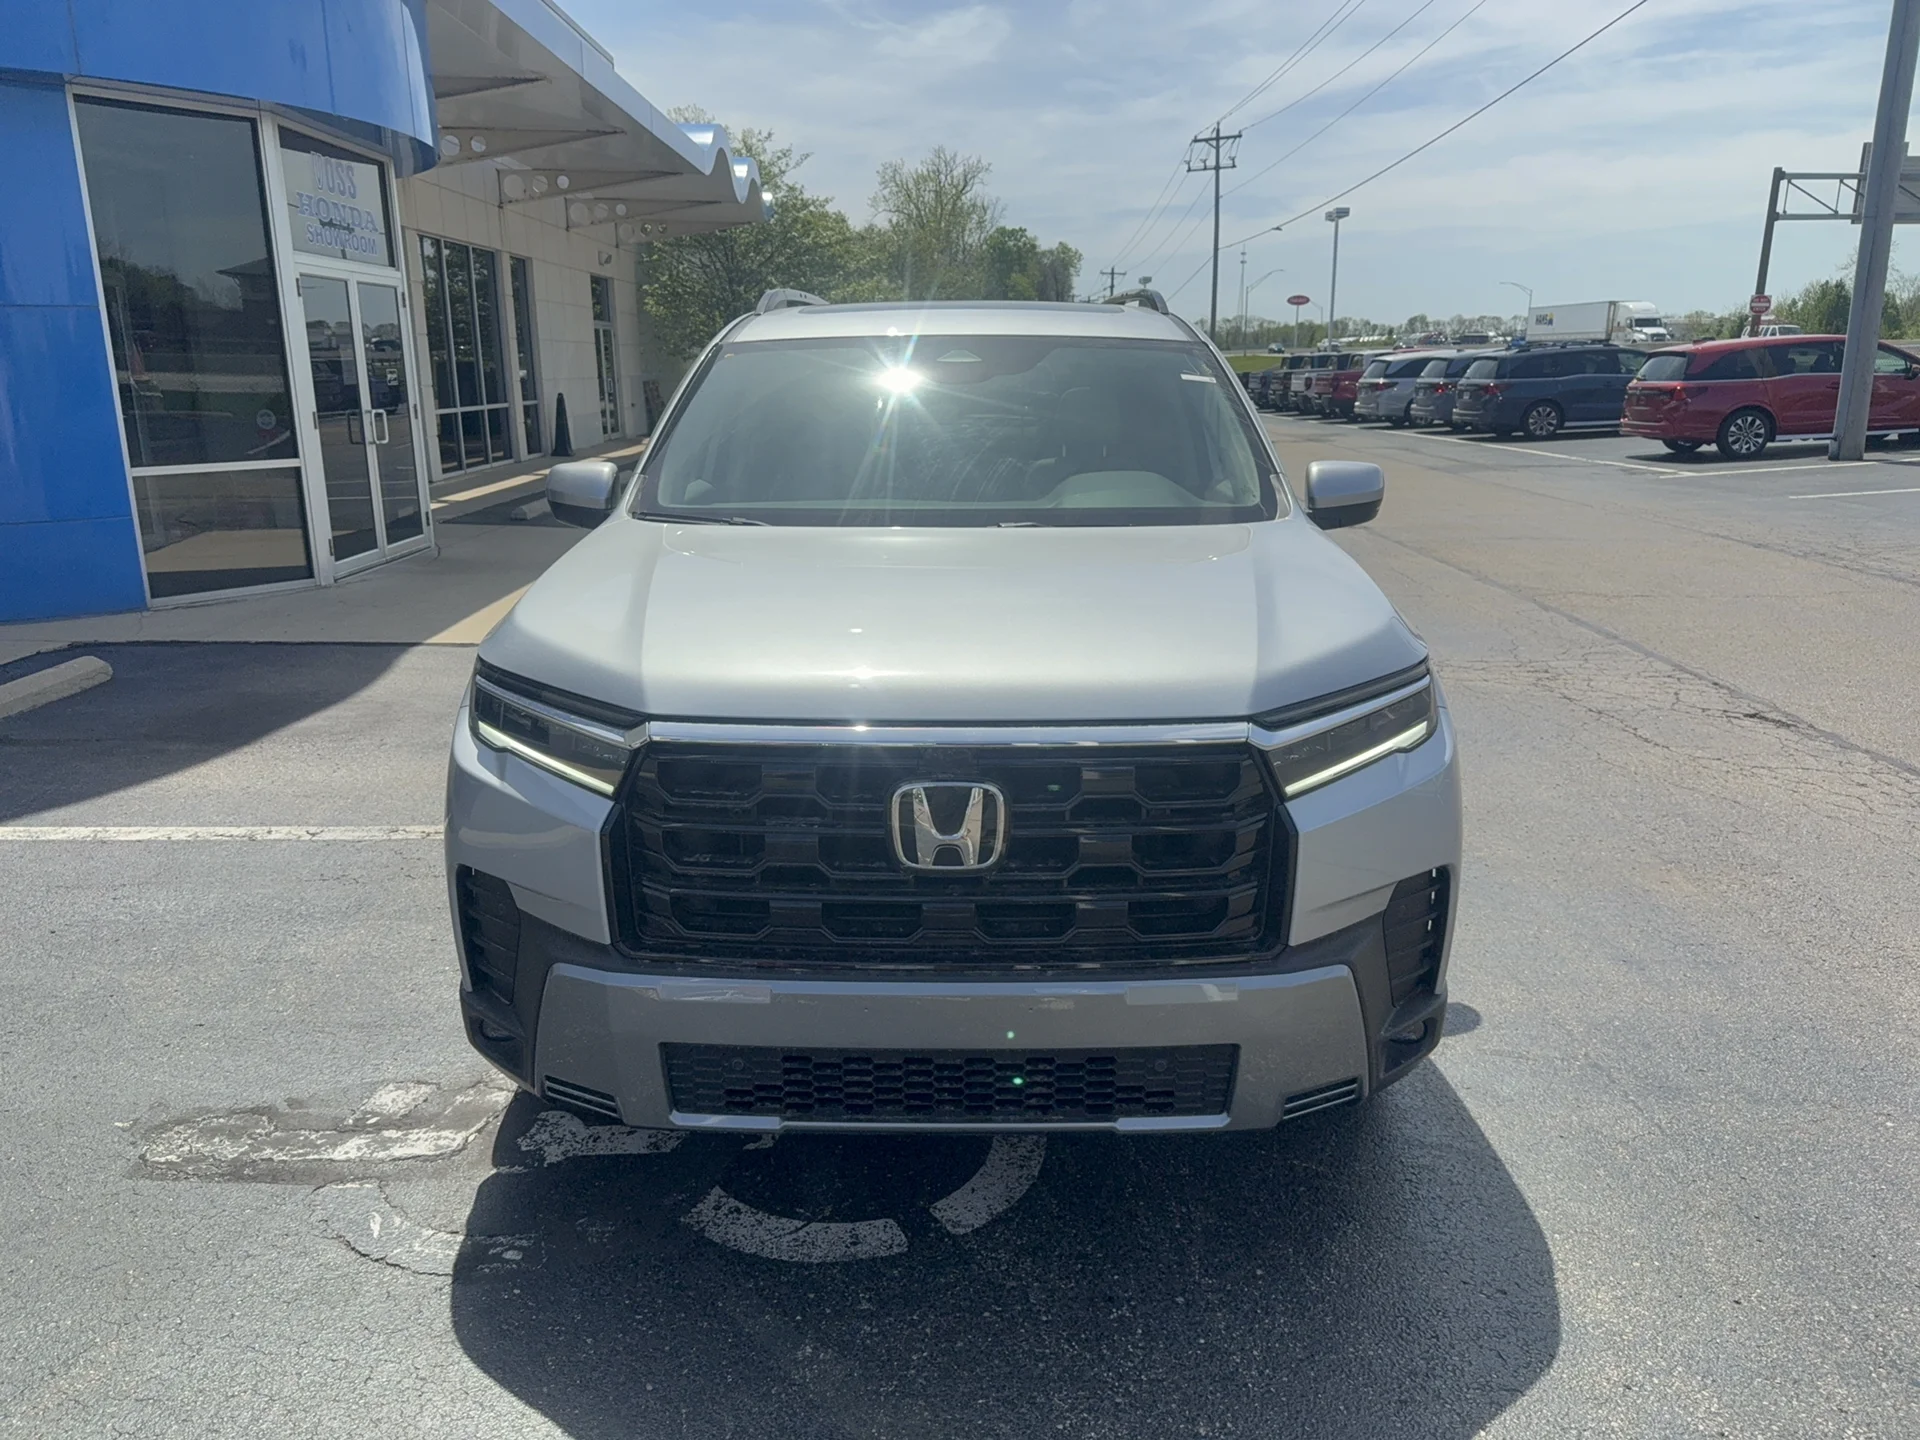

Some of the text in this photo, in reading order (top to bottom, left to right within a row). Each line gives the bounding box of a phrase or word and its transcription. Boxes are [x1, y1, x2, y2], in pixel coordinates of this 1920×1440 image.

[310, 151, 357, 199] VOSS
[296, 192, 379, 231] HONDA
[306, 223, 377, 255] SHOWROOM
